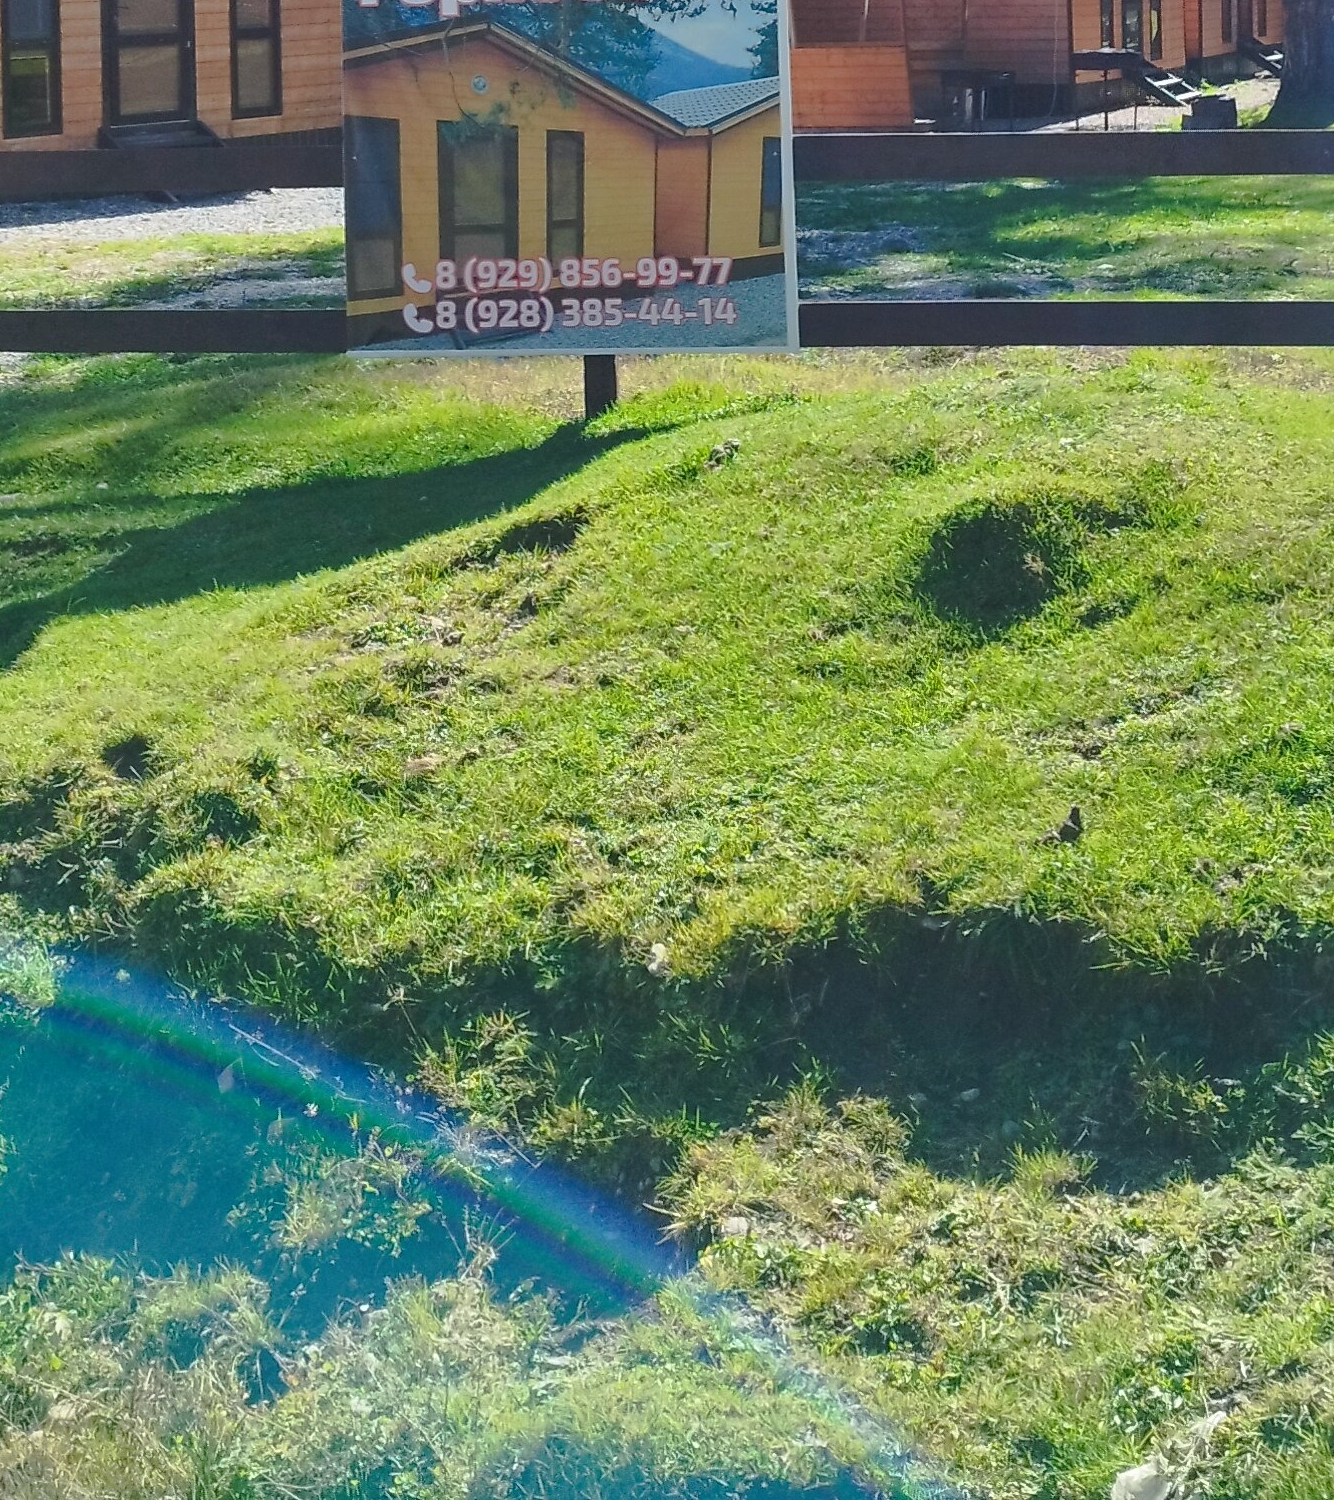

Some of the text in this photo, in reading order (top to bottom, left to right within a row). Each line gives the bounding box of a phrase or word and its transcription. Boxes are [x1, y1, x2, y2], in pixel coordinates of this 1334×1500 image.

[435, 257, 733, 293] 8 (929) 856-99-77
[435, 298, 737, 332] 8 (928) 385-44-14
